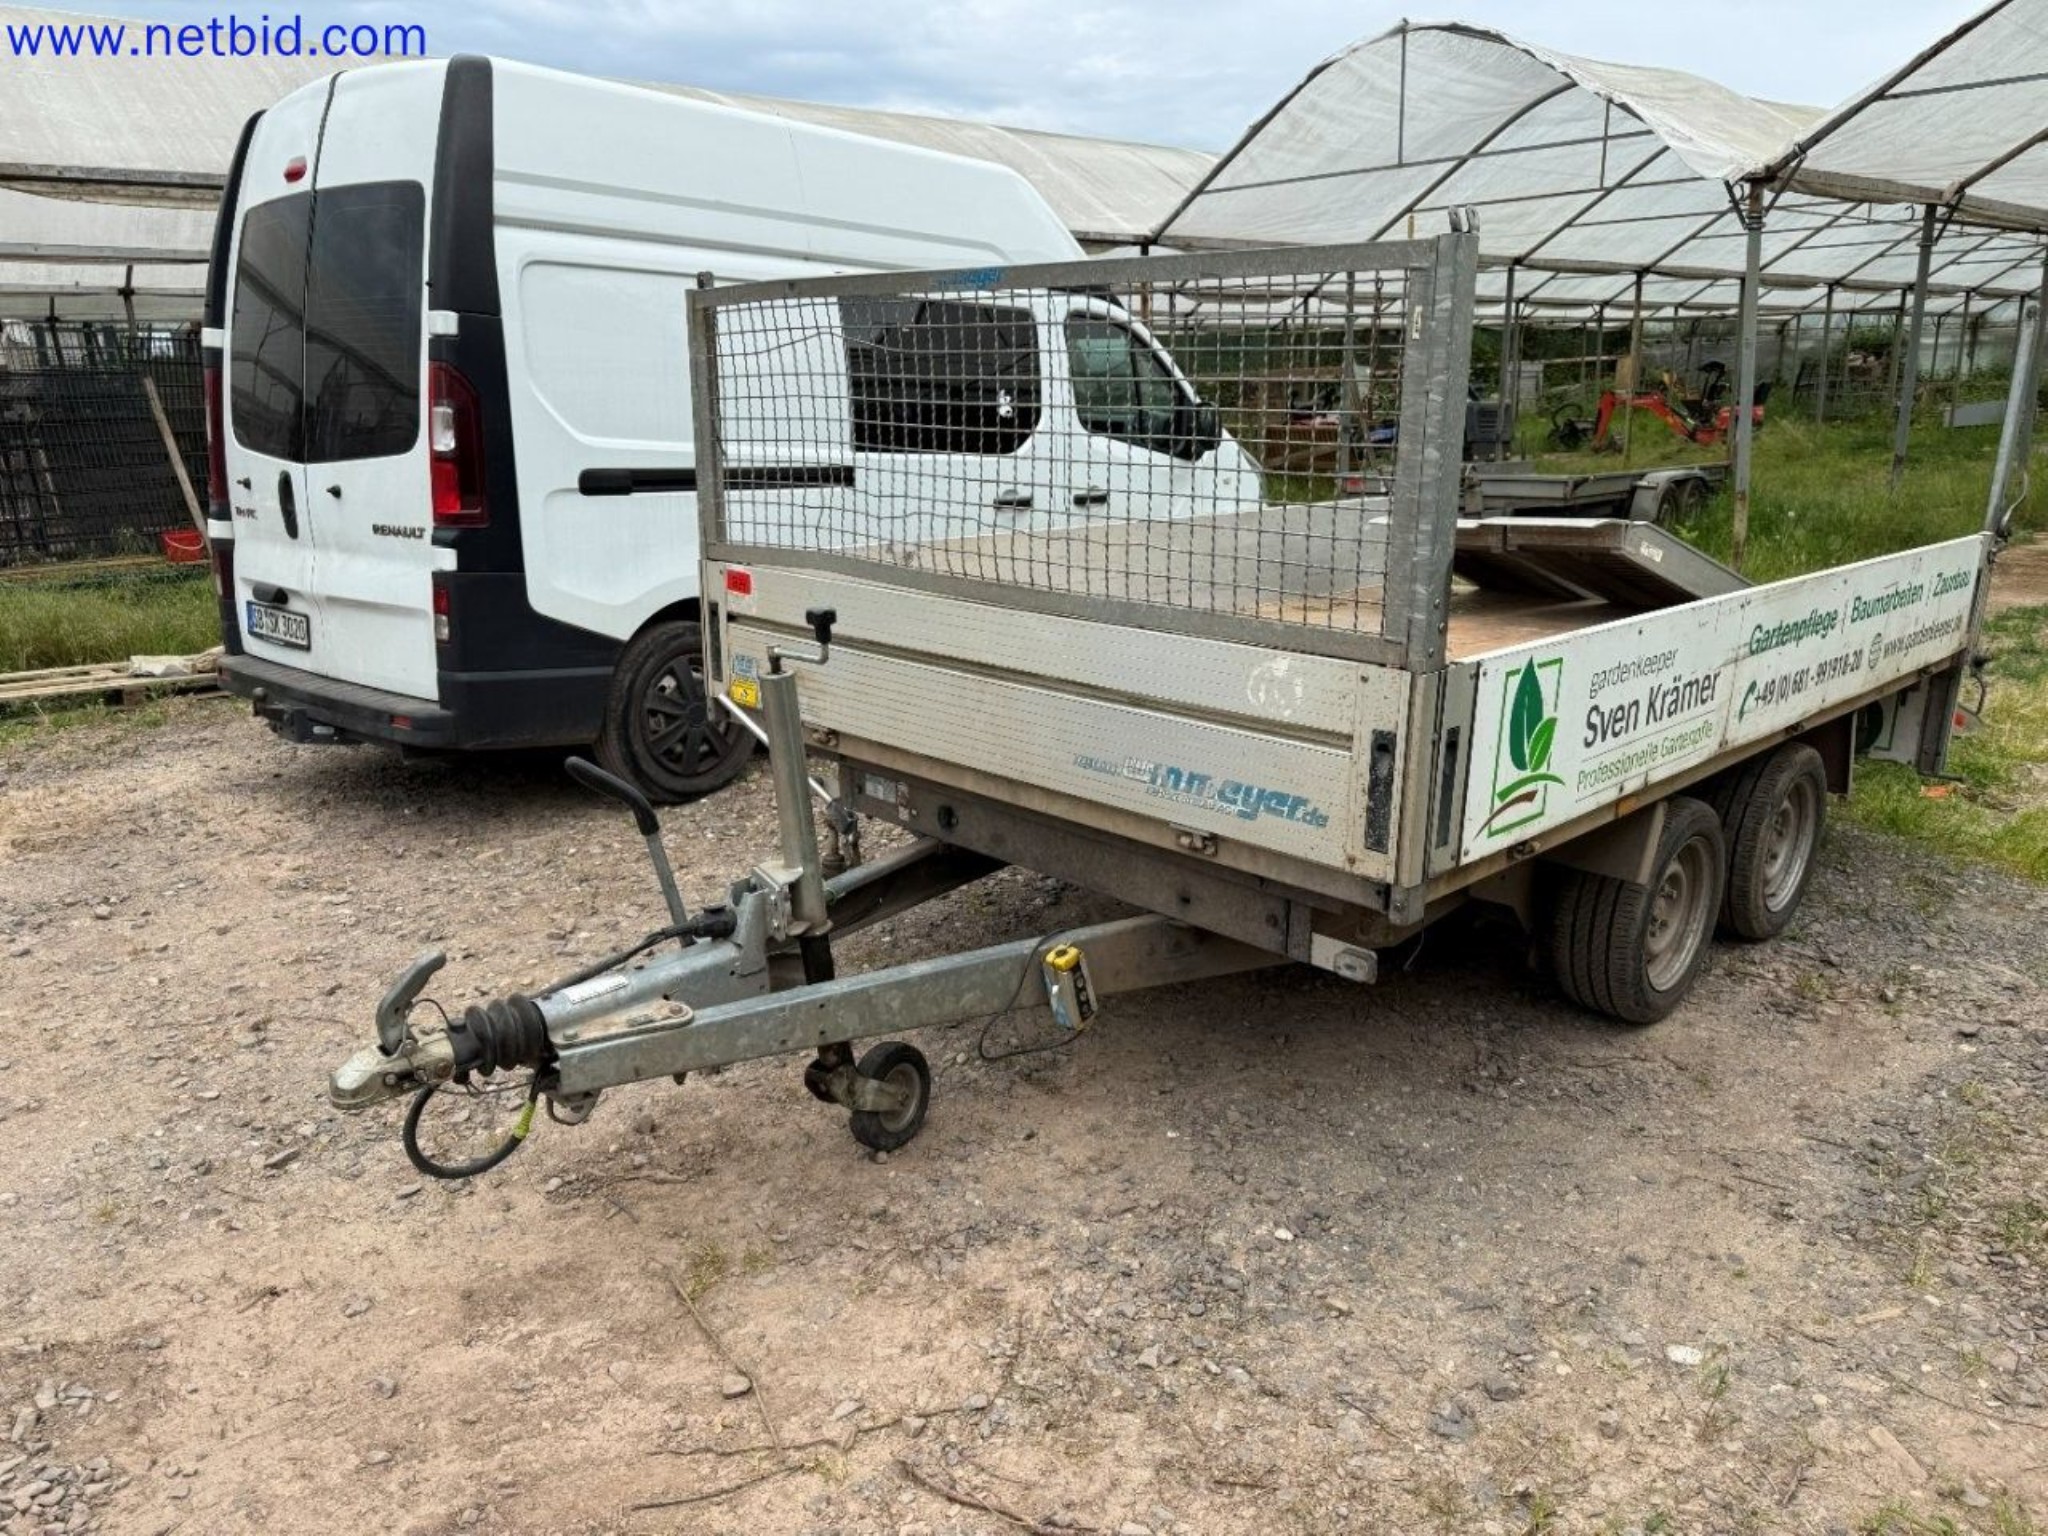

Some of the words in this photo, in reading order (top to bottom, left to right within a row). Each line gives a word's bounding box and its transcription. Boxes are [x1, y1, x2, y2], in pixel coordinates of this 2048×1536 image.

[371, 523, 426, 540] RENAULT
[1749, 608, 1838, 656] Gartenpflege
[1850, 580, 1924, 623] Baumarbeiten
[1589, 648, 1679, 700] gardenkeeper
[1583, 699, 1640, 748] Sven
[1646, 671, 1721, 726] Krämer
